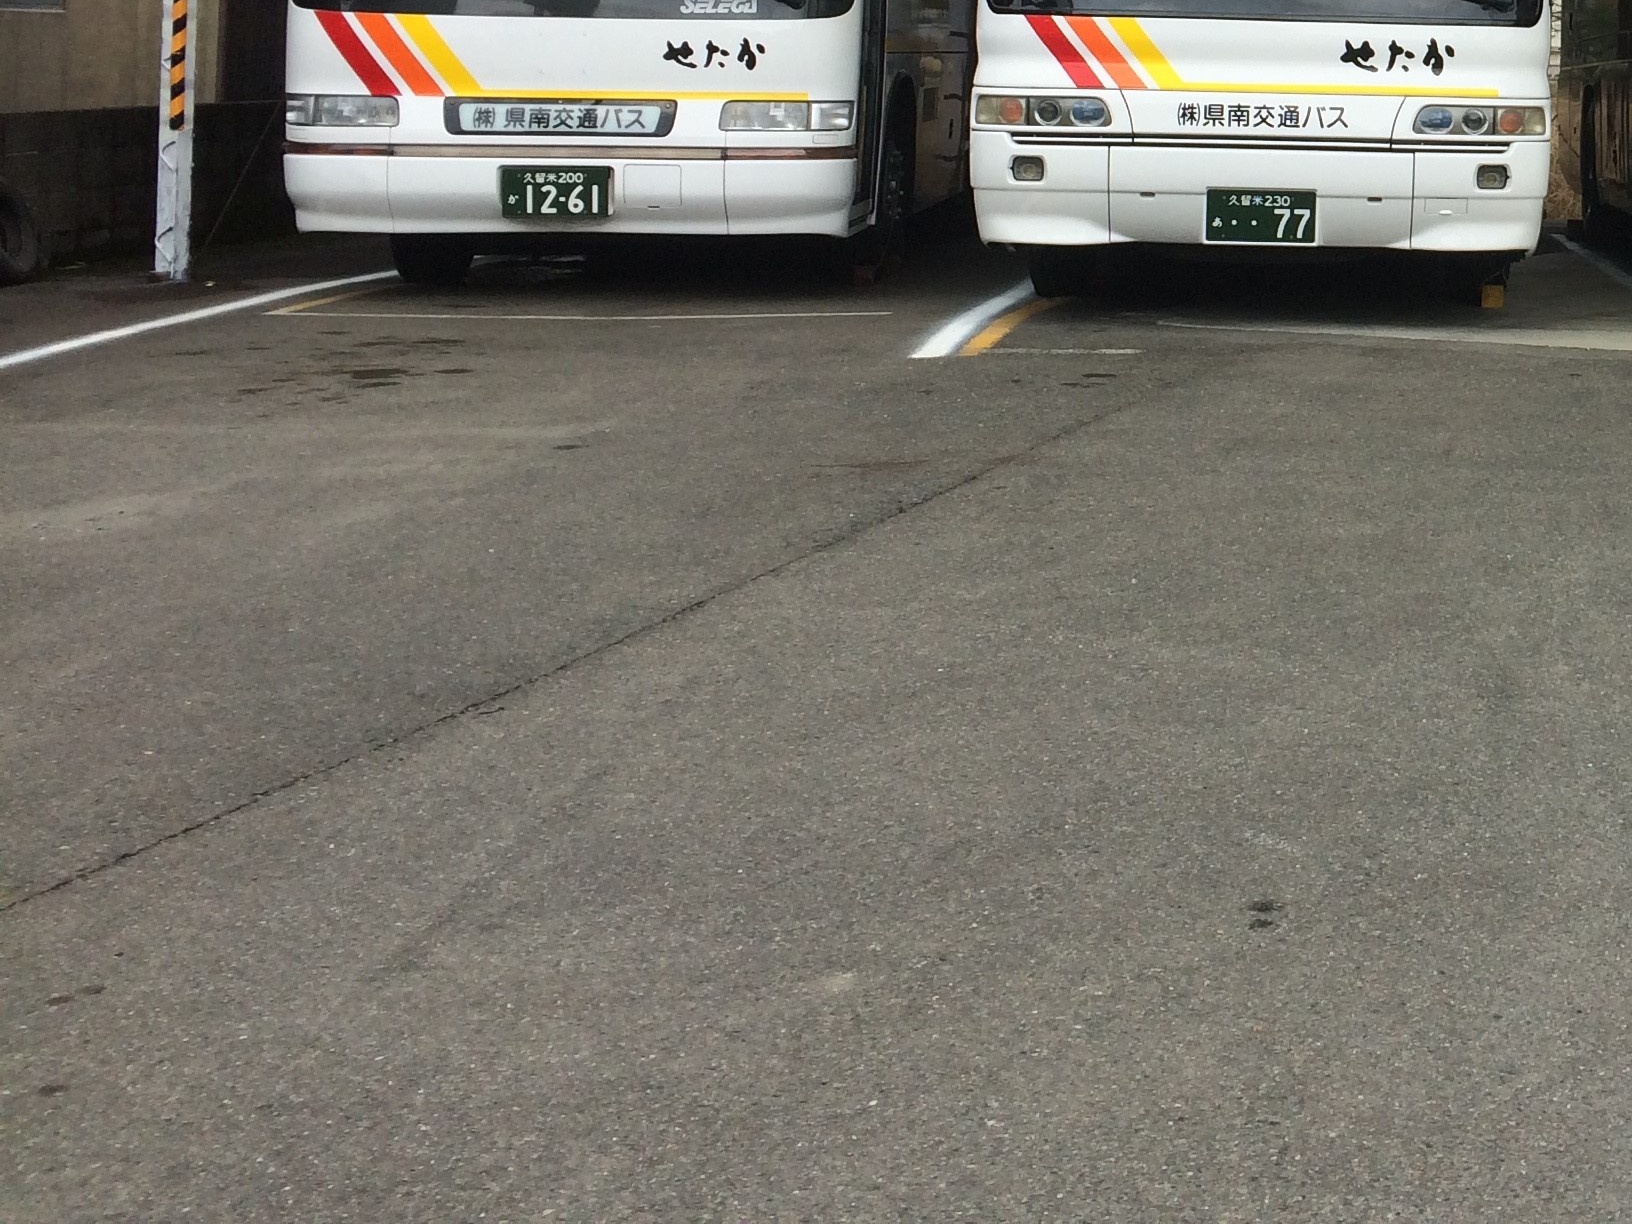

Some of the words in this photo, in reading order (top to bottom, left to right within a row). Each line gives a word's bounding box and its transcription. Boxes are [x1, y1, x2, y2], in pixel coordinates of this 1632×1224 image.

[663, 37, 766, 71] せたか
[1340, 38, 1455, 76] せたか
[526, 184, 599, 214] 12-61
